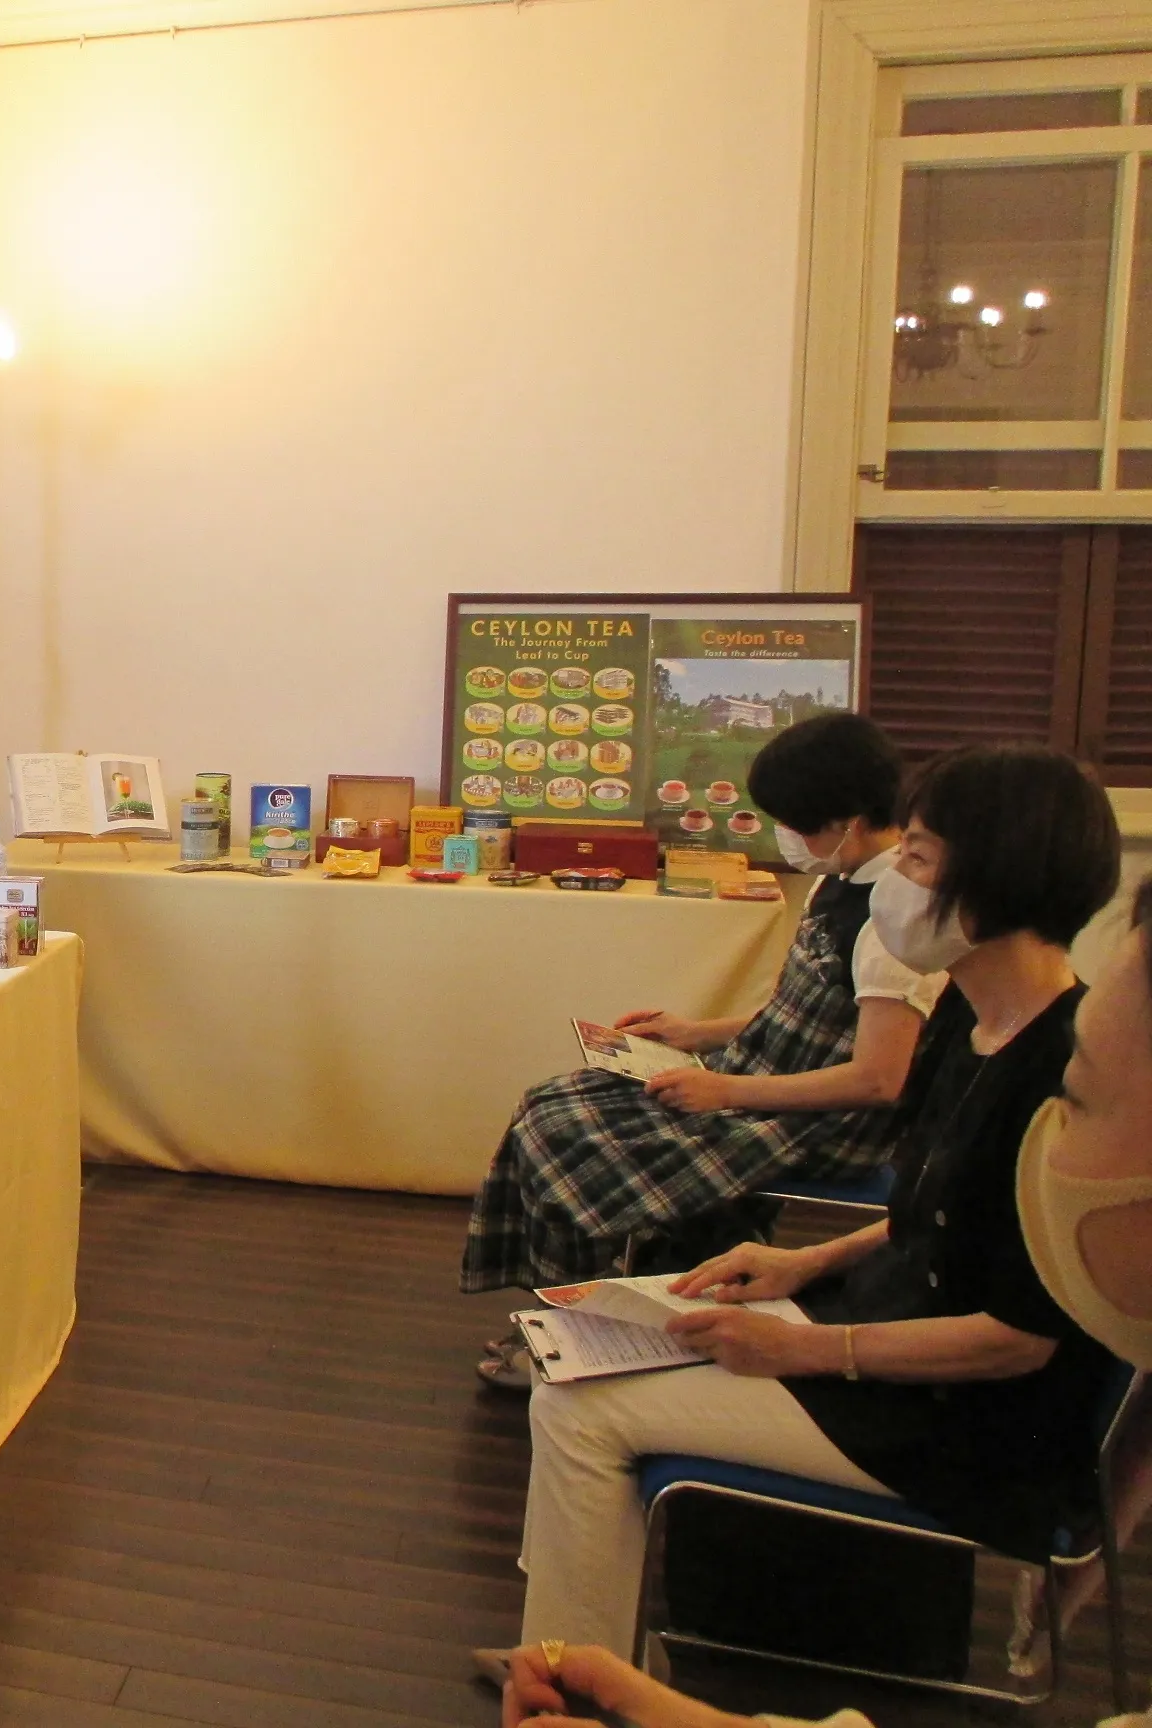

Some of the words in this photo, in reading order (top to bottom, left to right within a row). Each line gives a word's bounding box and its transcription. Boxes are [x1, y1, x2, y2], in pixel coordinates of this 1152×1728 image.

[471, 620, 573, 636] CEYLON
[587, 620, 634, 636] TEA
[493, 637, 516, 647] The
[520, 637, 571, 648] Journey
[576, 637, 608, 647] From
[701, 630, 765, 647] Ceylon
[772, 630, 806, 645] Tea
[515, 650, 542, 660] Leaf
[547, 651, 559, 660] to
[564, 651, 590, 661] Cup
[704, 649, 728, 657] Taste
[731, 649, 747, 657] the
[749, 649, 799, 658] difference
